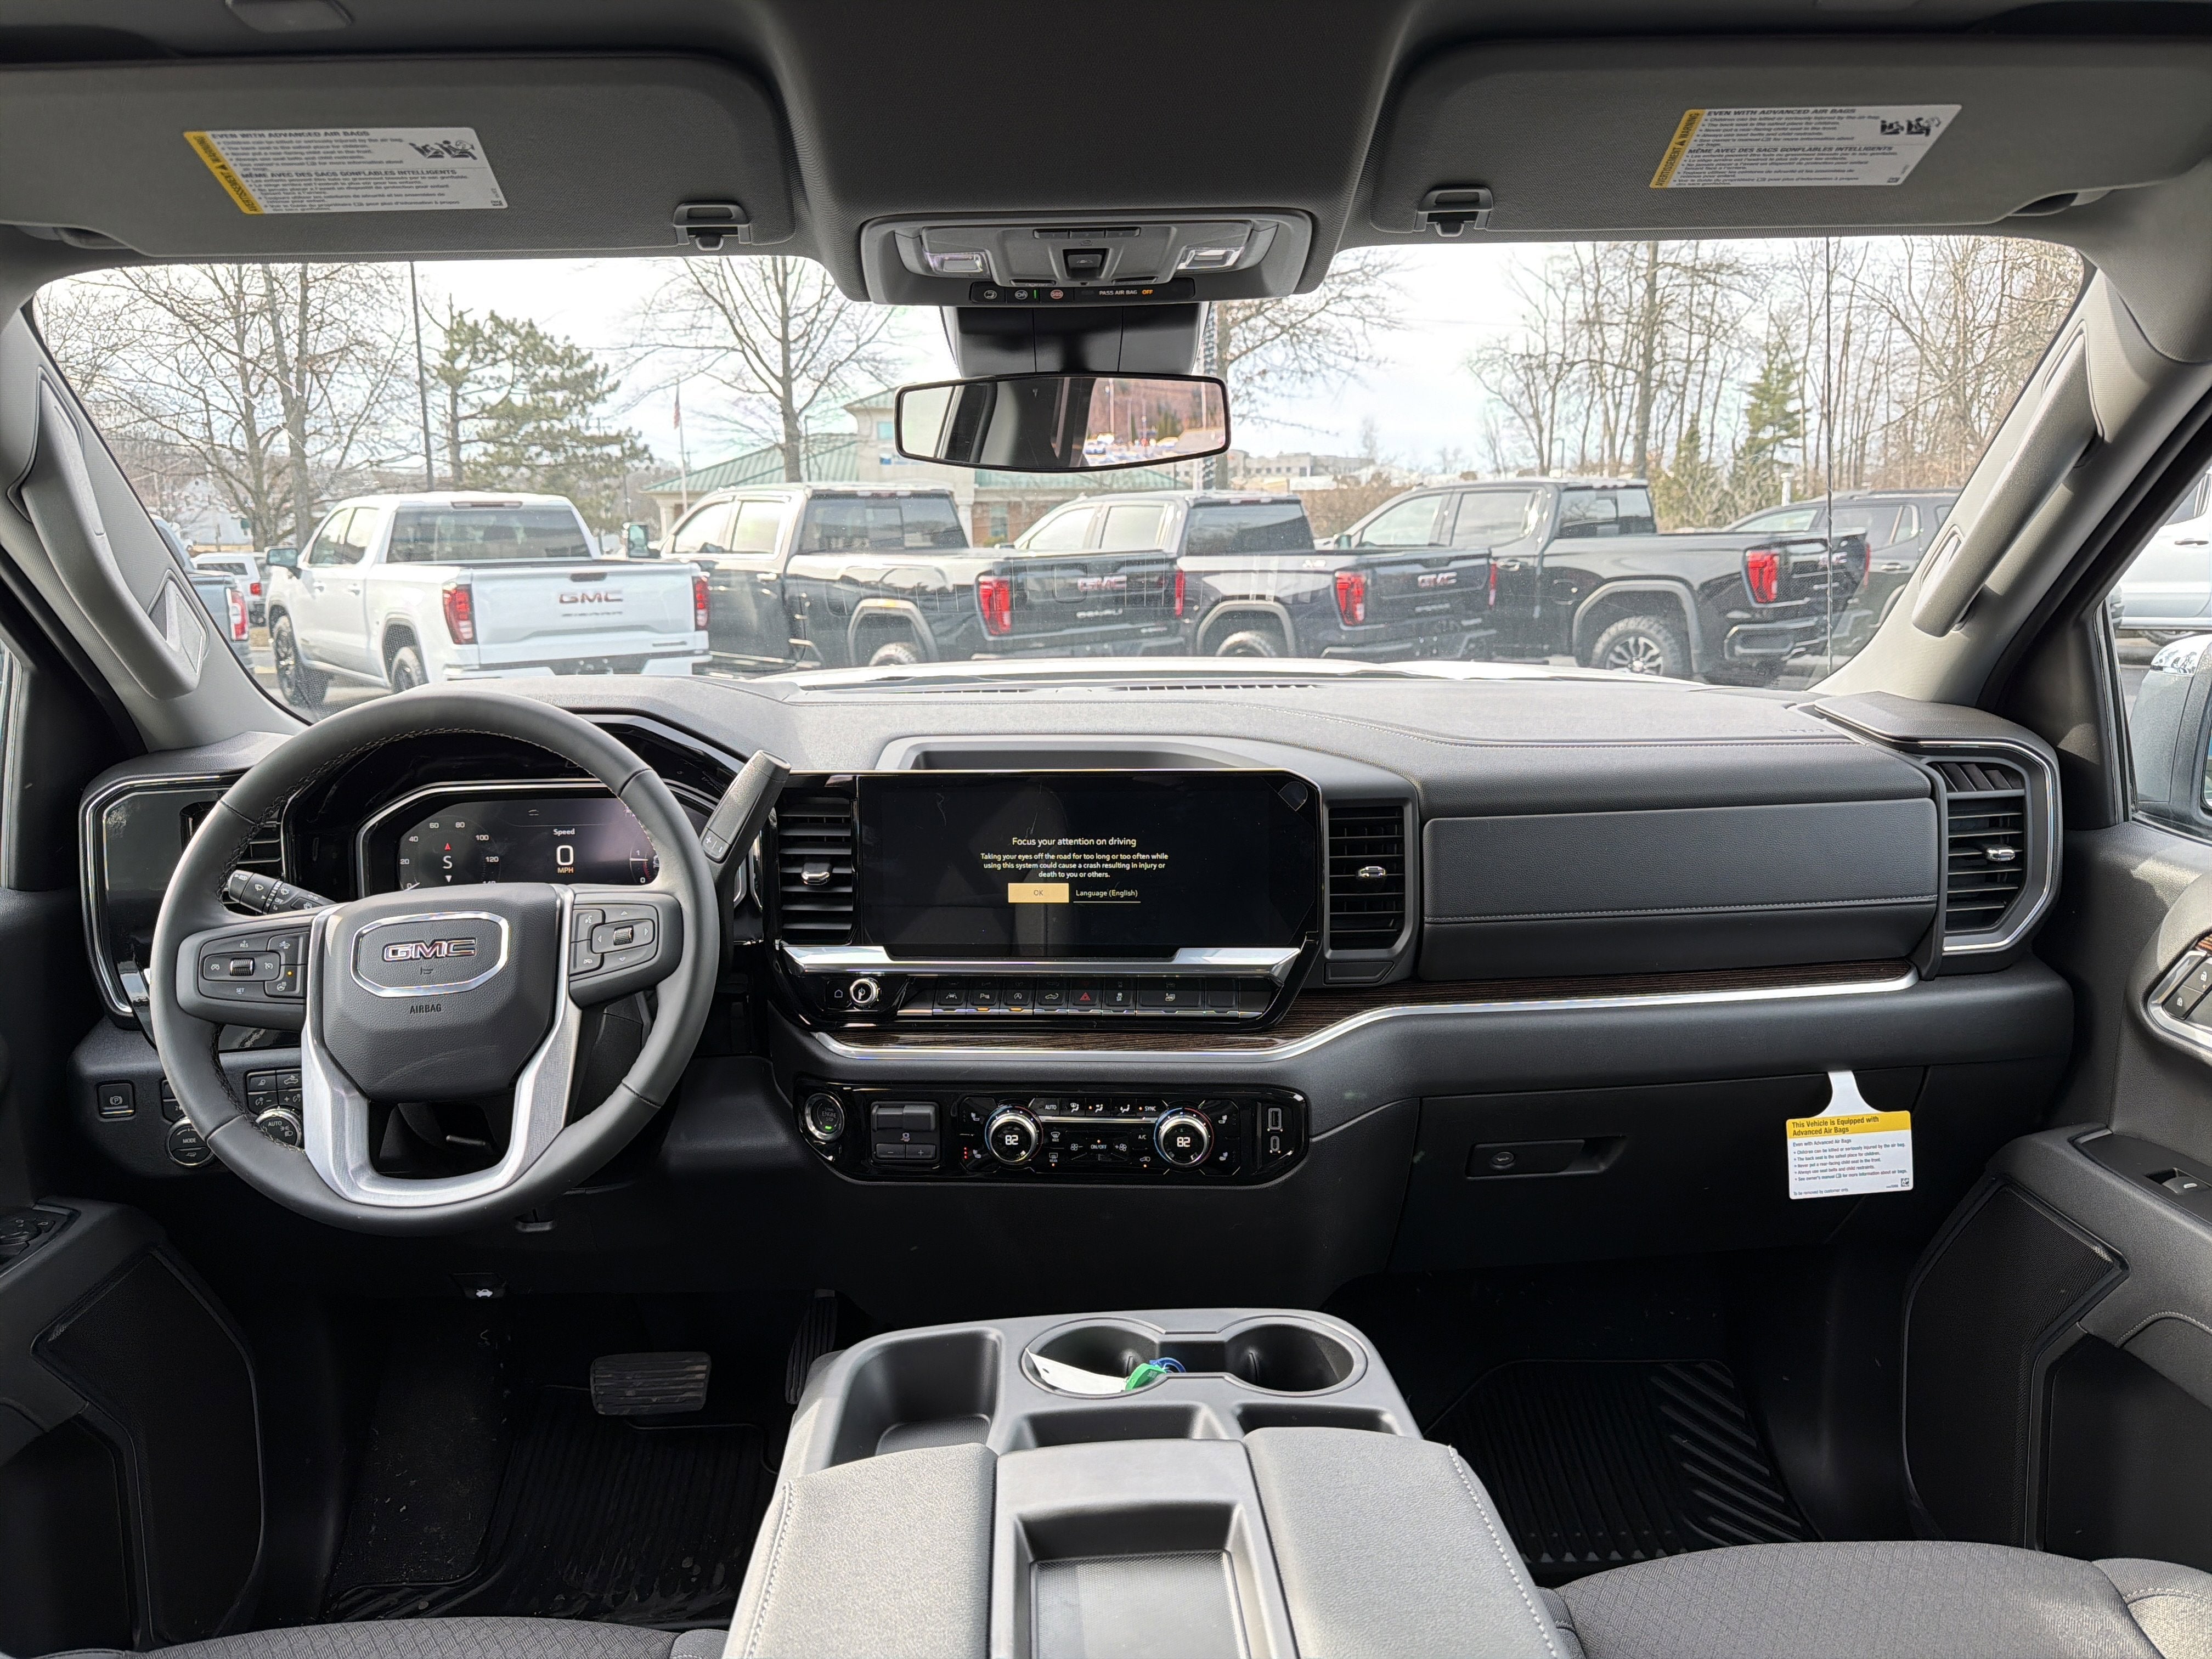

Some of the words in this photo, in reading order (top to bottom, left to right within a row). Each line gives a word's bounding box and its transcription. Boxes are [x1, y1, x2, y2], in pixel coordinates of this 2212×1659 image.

[1679, 112, 1700, 139] WARNING
[559, 591, 623, 603] GMC
[1037, 839, 1056, 847] your
[1108, 837, 1136, 847] driving
[557, 845, 573, 865] 0
[980, 853, 1001, 861] Taking
[1096, 853, 1110, 861] long
[443, 855, 452, 868] S
[1109, 889, 1137, 898] (English)
[383, 938, 477, 962] GMC
[410, 1003, 442, 1014] AIRBAG
[1836, 1117, 1864, 1125] Equipped
[1005, 1135, 1018, 1145] 82
[1177, 1137, 1190, 1147] 82
